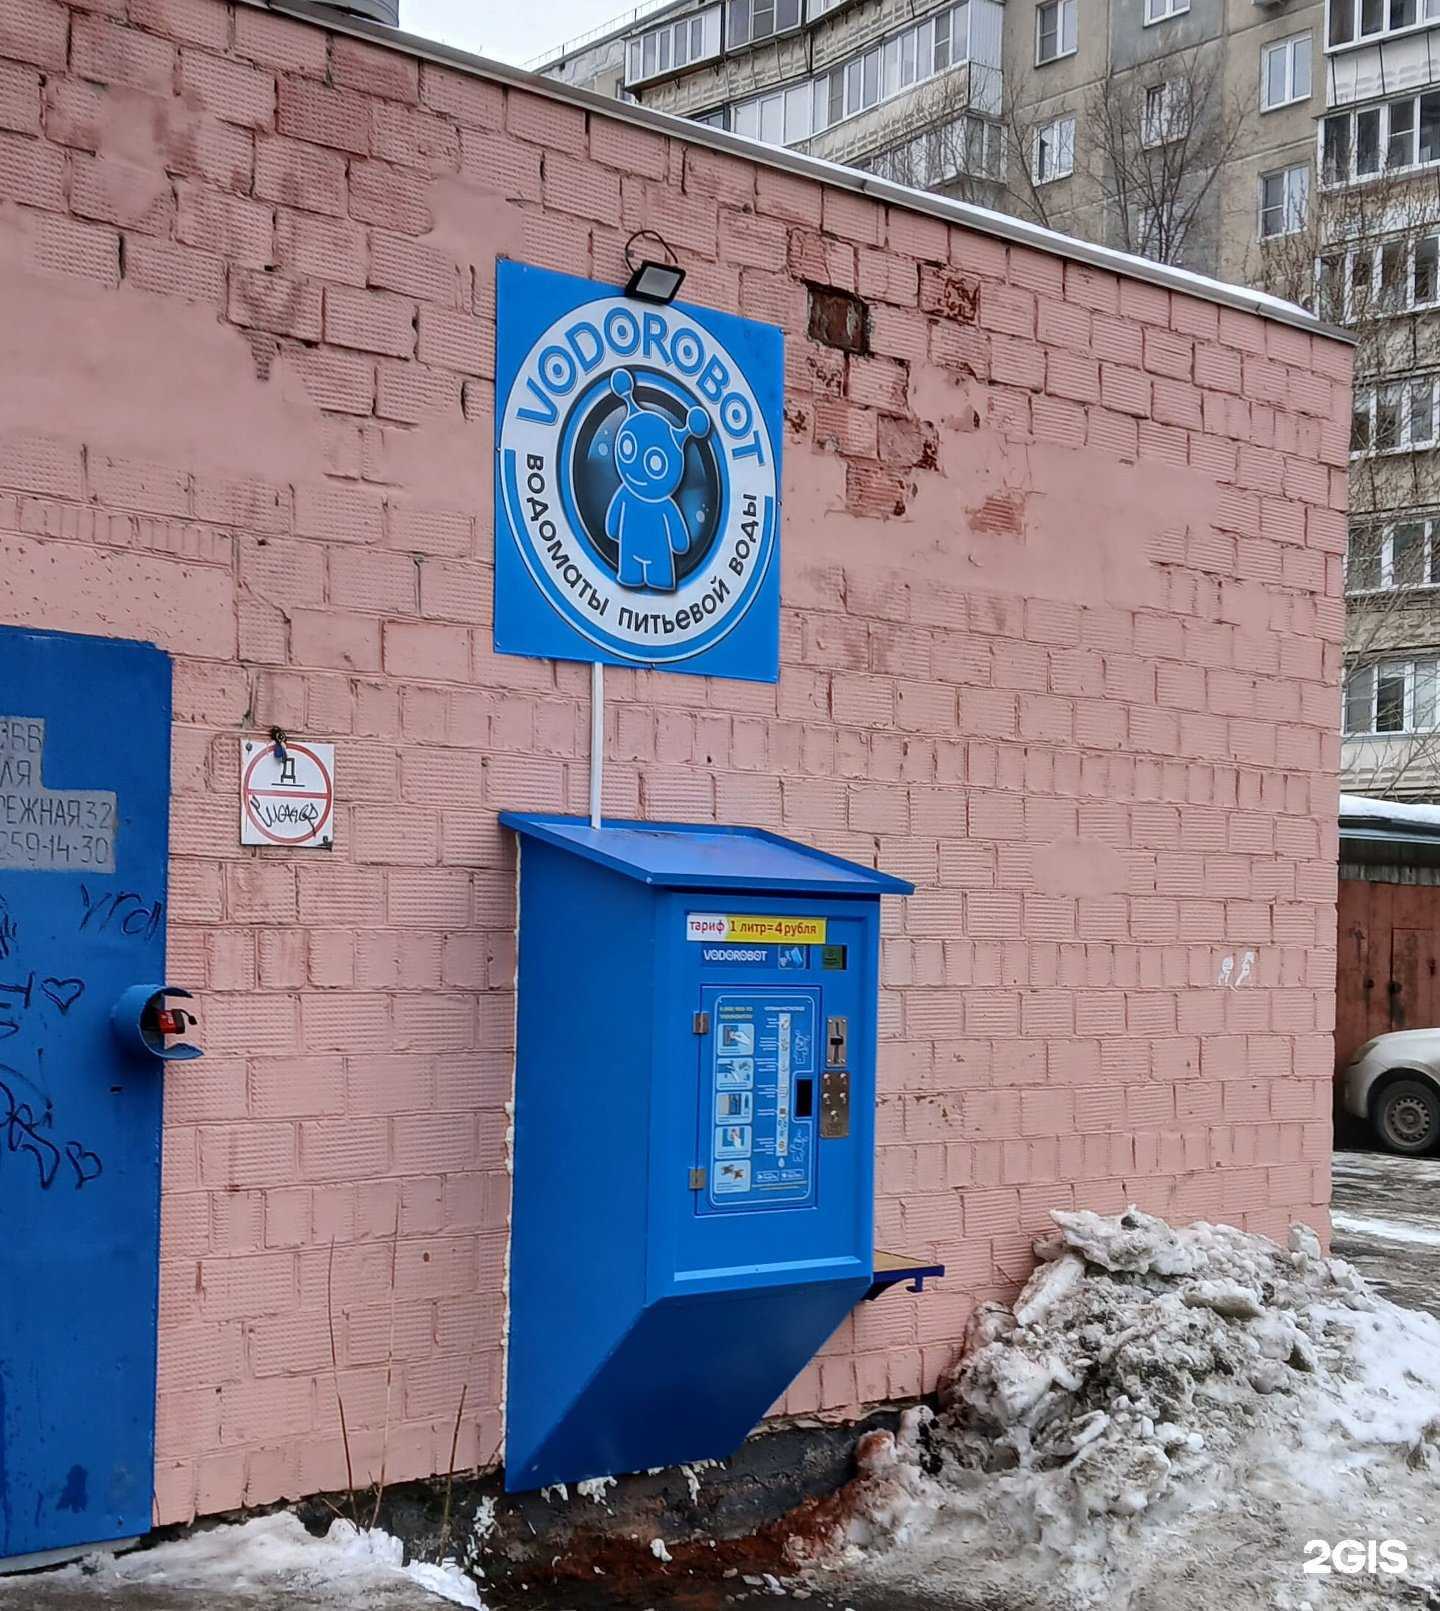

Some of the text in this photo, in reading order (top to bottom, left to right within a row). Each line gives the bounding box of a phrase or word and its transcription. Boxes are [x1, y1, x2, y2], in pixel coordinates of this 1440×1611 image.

[516, 307, 765, 467] VODOROBOT
[690, 919, 725, 934] тариф
[729, 920, 737, 932] 1
[703, 949, 768, 961] VODOROBOT
